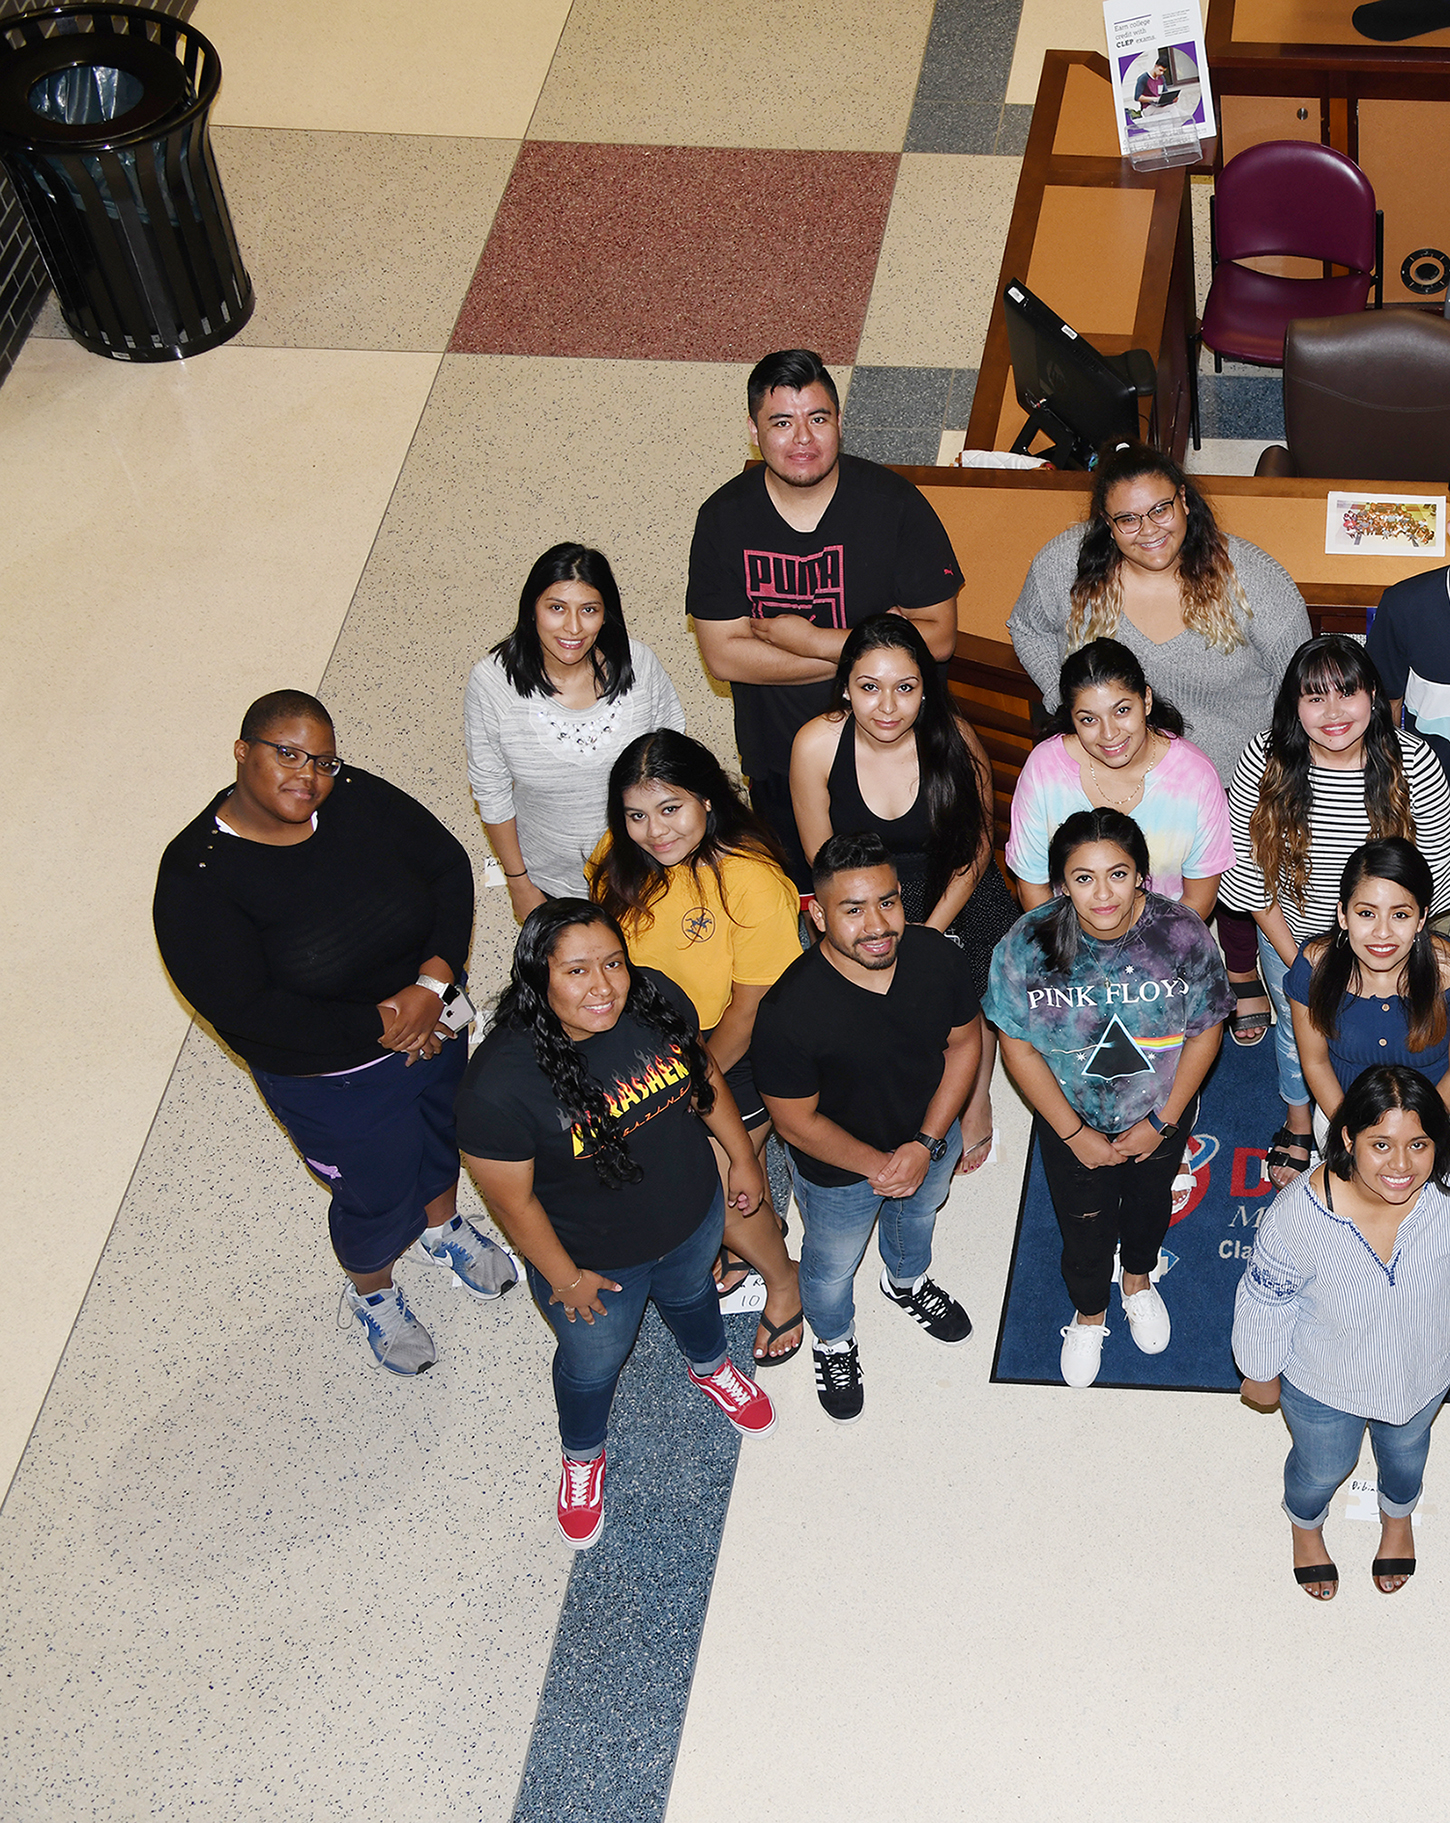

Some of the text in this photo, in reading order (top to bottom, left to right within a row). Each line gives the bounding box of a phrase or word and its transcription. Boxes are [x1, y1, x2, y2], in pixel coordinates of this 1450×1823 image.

[1113, 19, 1151, 32] Earn college
[1114, 28, 1147, 41] credit with
[1115, 38, 1134, 48] CLEP
[747, 551, 841, 596] PUMA
[1027, 985, 1098, 1010] PINK
[741, 1295, 761, 1307] 10
